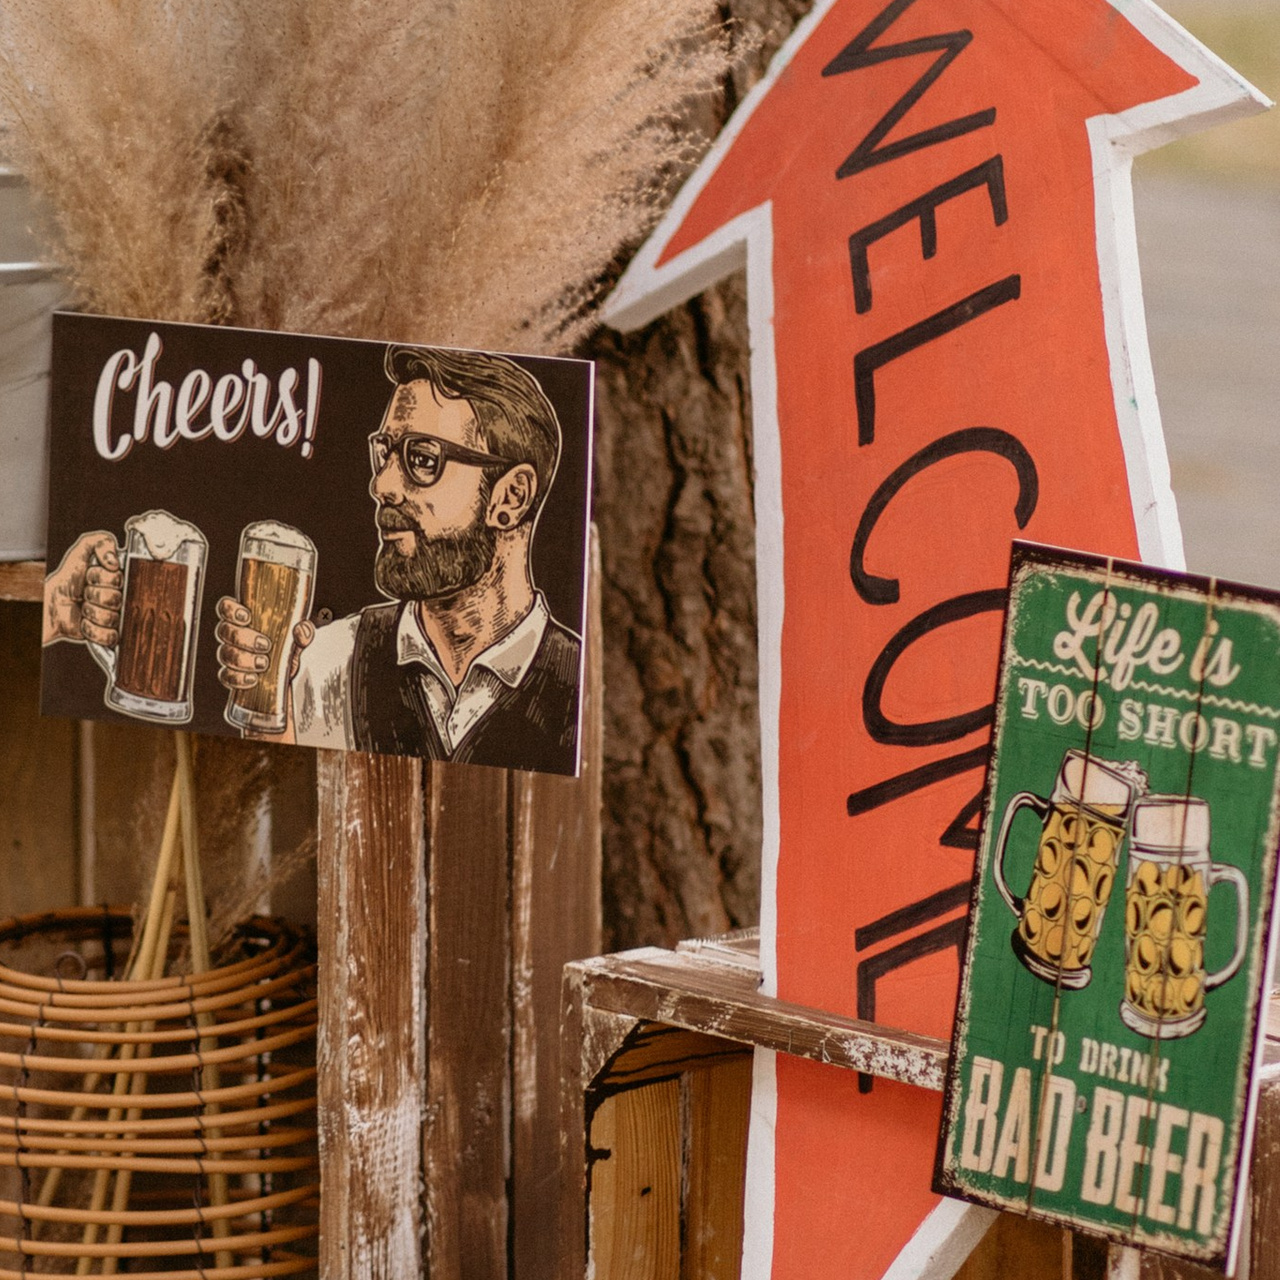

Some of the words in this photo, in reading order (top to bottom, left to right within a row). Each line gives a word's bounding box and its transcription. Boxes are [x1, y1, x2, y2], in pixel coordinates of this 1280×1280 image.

[93, 331, 323, 462] Cheers!
[1053, 590, 1185, 692] Life
[1189, 619, 1242, 687] is
[1017, 676, 1106, 731] TOO
[1117, 697, 1278, 768] SHORT
[1029, 1024, 1066, 1065] TO
[1079, 1036, 1170, 1093] DRINK
[960, 1055, 1077, 1193] BAD
[1080, 1085, 1225, 1237] BEER
